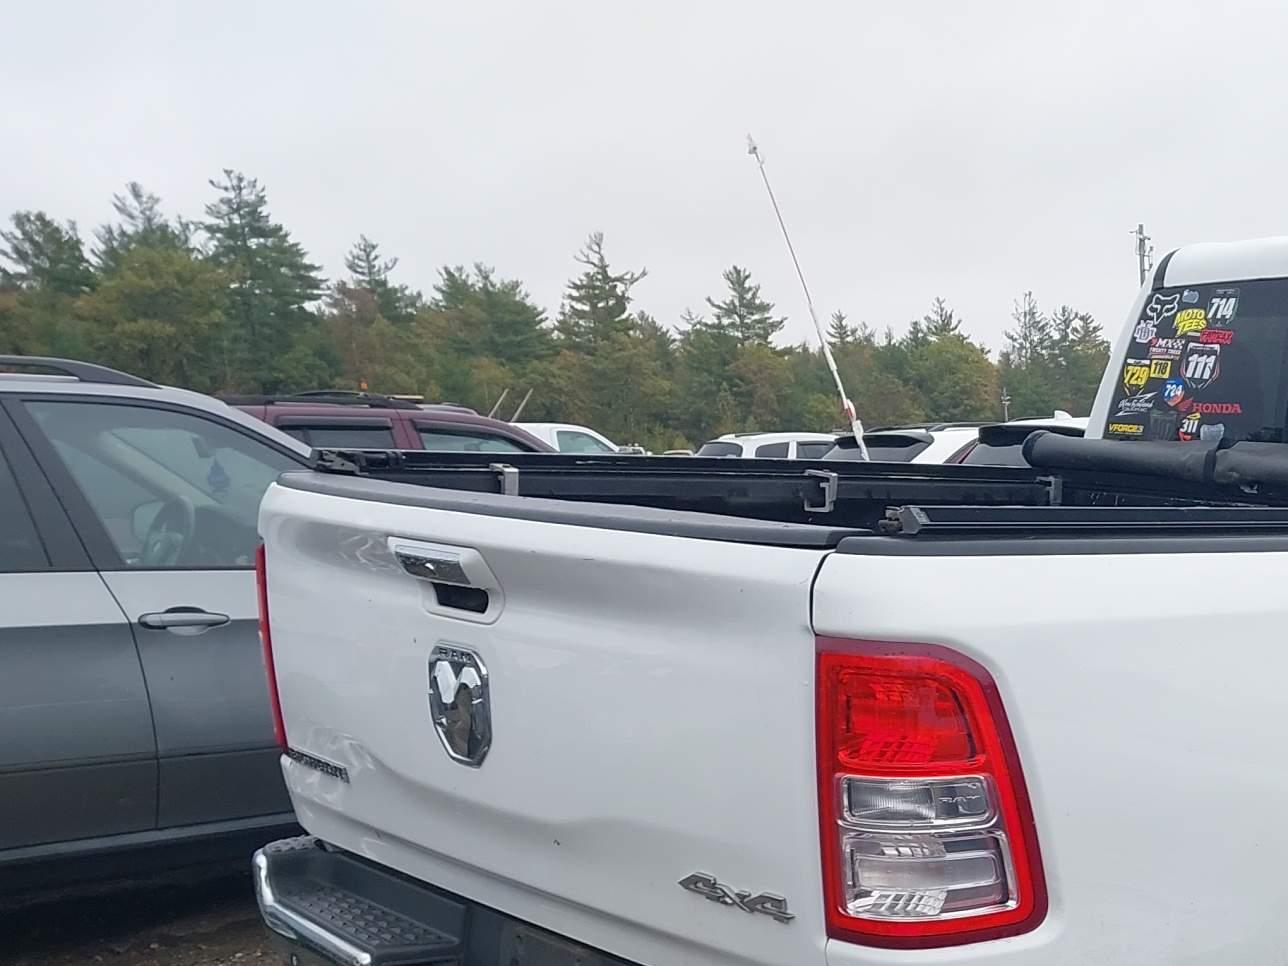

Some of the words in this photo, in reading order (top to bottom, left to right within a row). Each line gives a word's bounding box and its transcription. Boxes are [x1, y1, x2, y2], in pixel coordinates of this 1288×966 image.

[1207, 297, 1236, 319] 714
[1173, 309, 1205, 329] MOTO
[1175, 318, 1207, 337] TEES
[1124, 365, 1150, 385] 729
[1185, 353, 1217, 380] 111
[1163, 384, 1183, 397] 724
[1193, 402, 1242, 414] HONDA
[1179, 418, 1200, 433] 311
[437, 646, 475, 664] RAM
